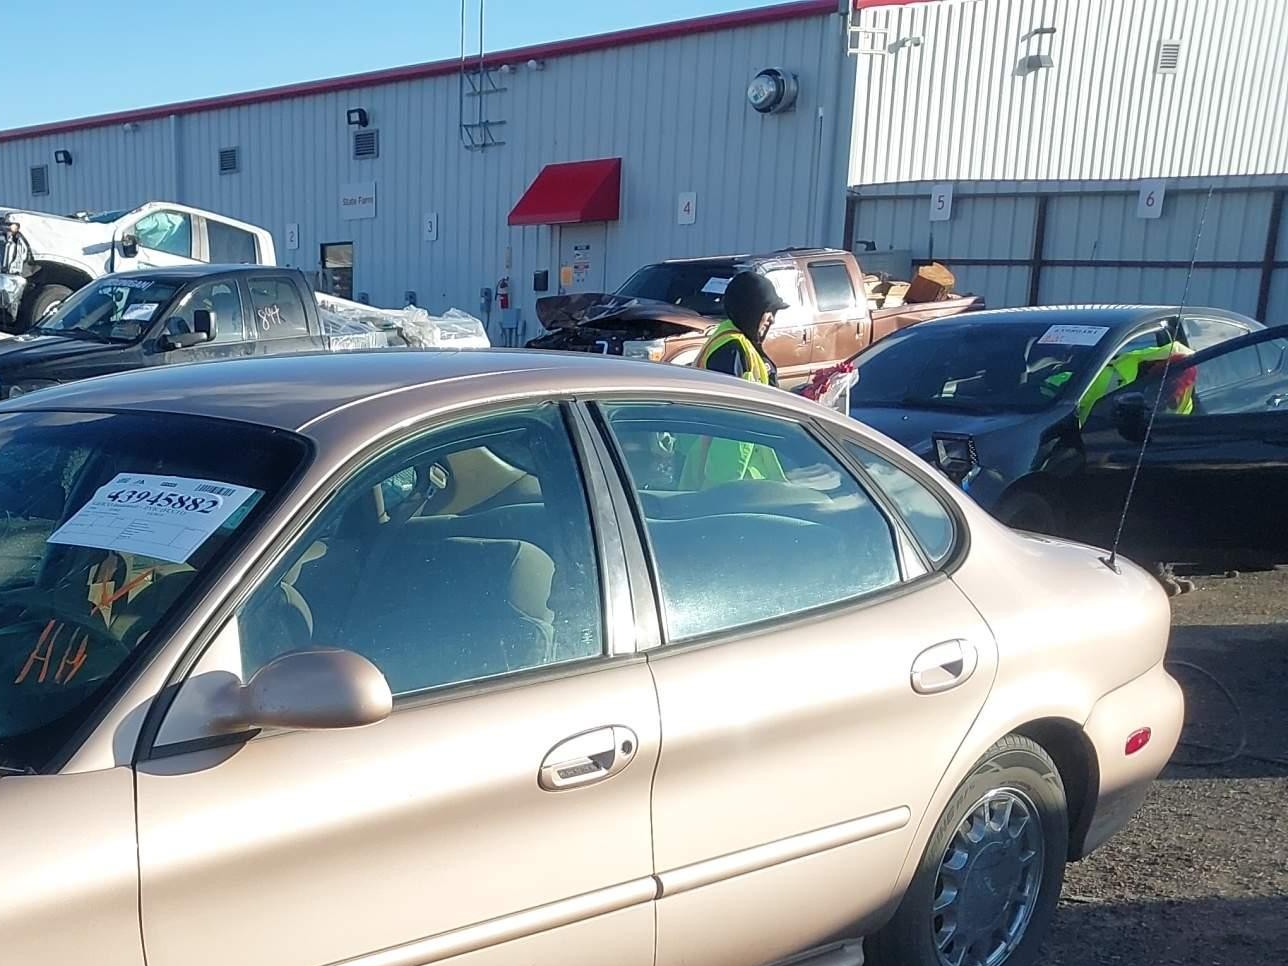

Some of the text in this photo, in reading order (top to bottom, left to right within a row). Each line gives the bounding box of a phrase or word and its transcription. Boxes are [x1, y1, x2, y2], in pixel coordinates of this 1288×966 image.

[343, 195, 373, 206] State Farm
[937, 194, 945, 210] 5
[1145, 191, 1154, 207] 6
[683, 201, 690, 215] 4
[427, 221, 433, 232] 3
[288, 231, 294, 242] 2
[107, 490, 219, 514] 43945882
